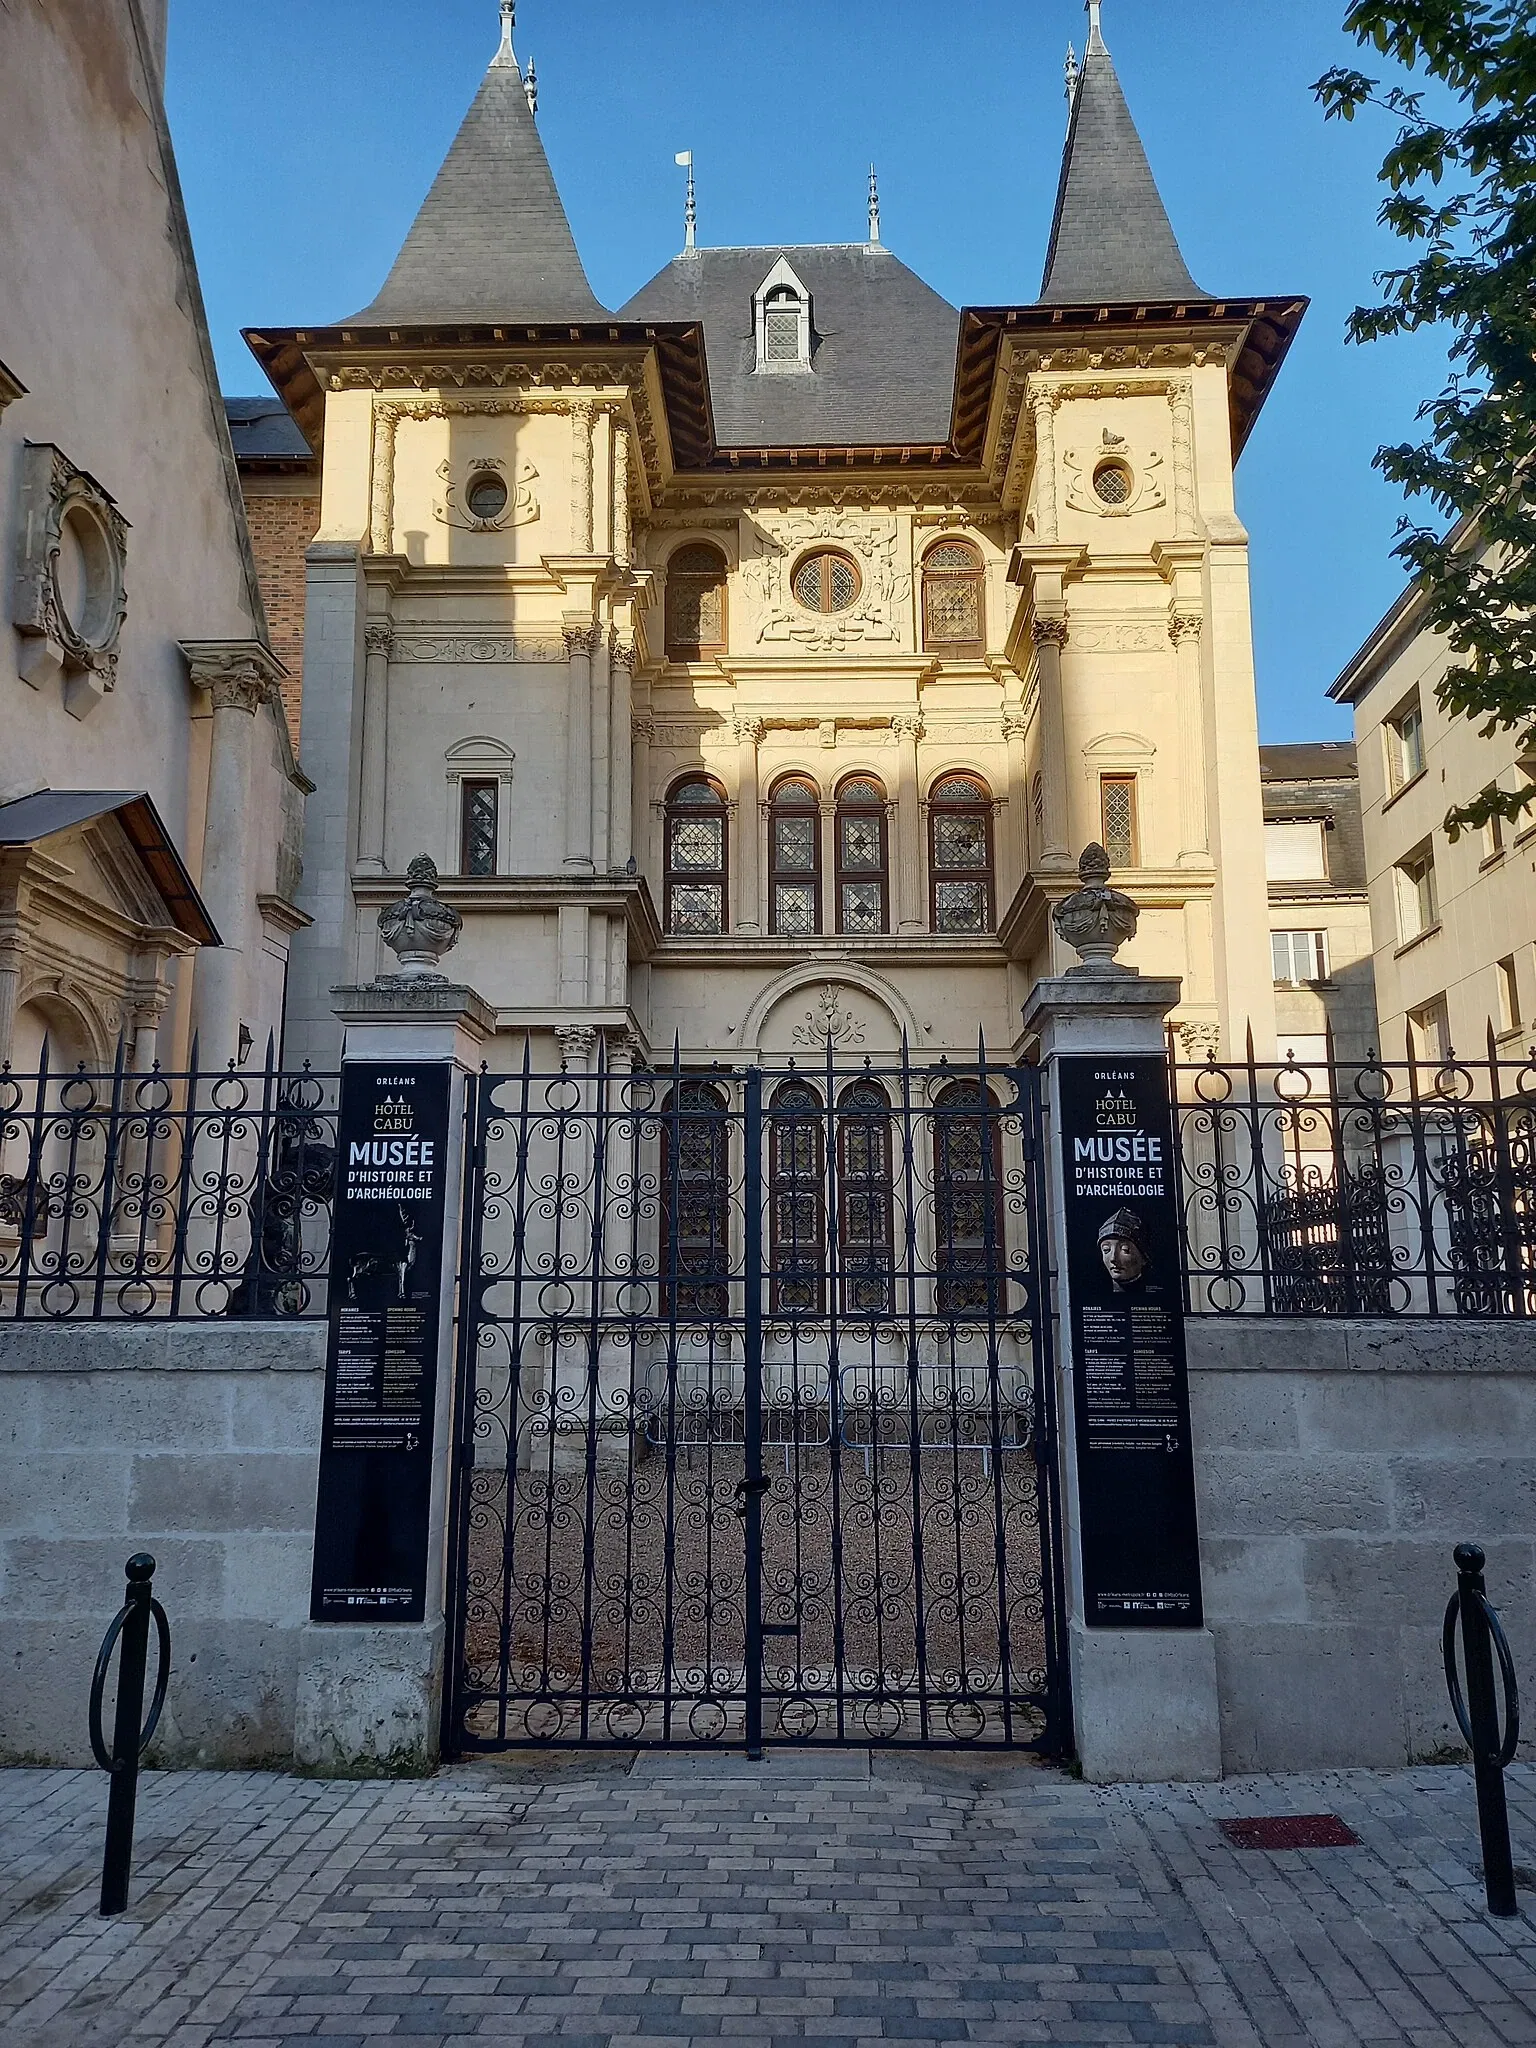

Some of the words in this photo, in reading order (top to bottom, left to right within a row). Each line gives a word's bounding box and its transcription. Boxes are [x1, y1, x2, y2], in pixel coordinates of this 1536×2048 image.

[376, 1076, 416, 1085] ORLÉANS
[1094, 1070, 1135, 1080] ORLÉANS
[373, 1118, 413, 1130] CABU
[1096, 1113, 1137, 1125] CABU
[348, 1133, 435, 1166] MUSÉE
[1074, 1129, 1163, 1162] MUSÉE
[347, 1170, 414, 1182] D'HISTOIRE
[418, 1170, 433, 1182] ET
[1075, 1167, 1144, 1179] D'HISTOIRE
[1149, 1167, 1163, 1178] ET
[346, 1185, 433, 1200] D'ARCHÉOLOGIE
[1076, 1181, 1165, 1196] D'ARCHÉOLOGIE
